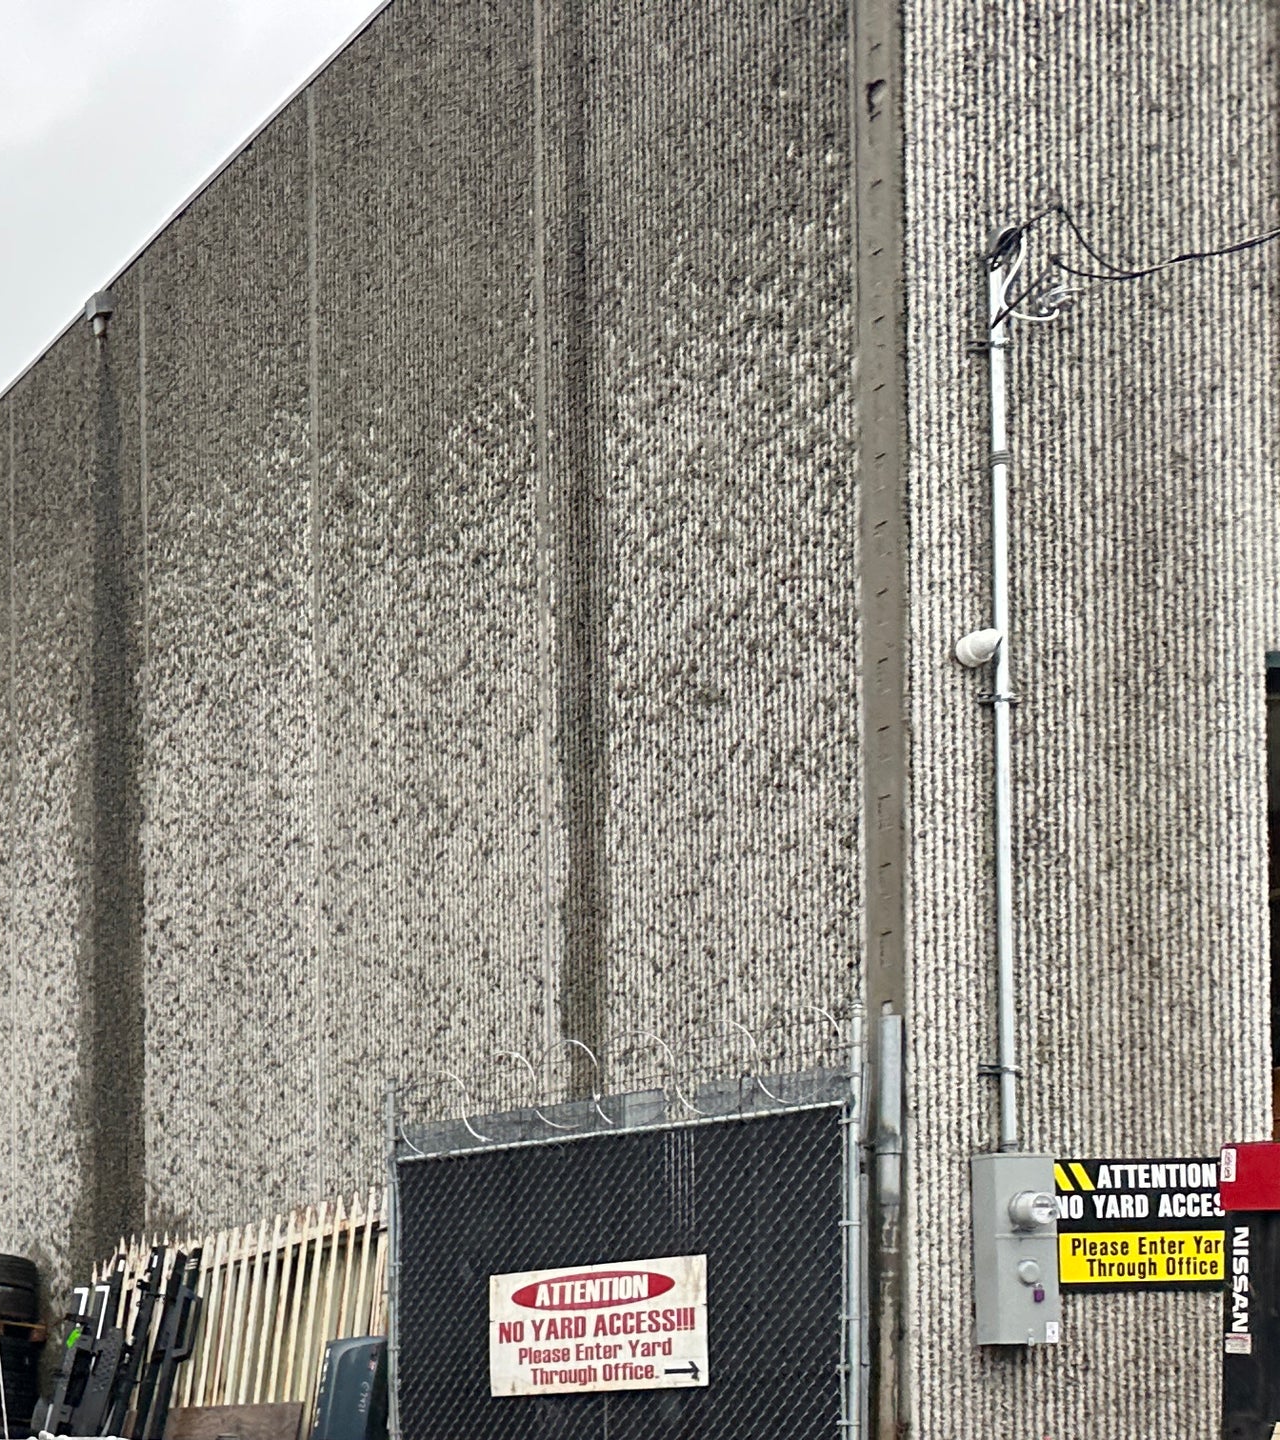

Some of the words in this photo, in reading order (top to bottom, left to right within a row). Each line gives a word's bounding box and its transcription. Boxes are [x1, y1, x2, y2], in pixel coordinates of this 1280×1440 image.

[1096, 1163, 1219, 1189] ATTENTION
[1056, 1194, 1083, 1219] NO
[1092, 1193, 1149, 1218] YARD
[1071, 1237, 1129, 1257] Please
[1138, 1236, 1184, 1255] Enter
[1193, 1236, 1225, 1254] Yar
[1086, 1258, 1157, 1279] Through
[1166, 1257, 1218, 1276] Office
[1232, 1227, 1249, 1332] NISSAN
[535, 1273, 649, 1307] ATTENTION
[498, 1321, 524, 1344] NO
[531, 1316, 587, 1341] YARD
[593, 1307, 695, 1337] ACCESS!!!
[518, 1347, 571, 1366] Please
[576, 1341, 623, 1362] Enter
[628, 1337, 672, 1358] Yard
[531, 1363, 597, 1386] Through
